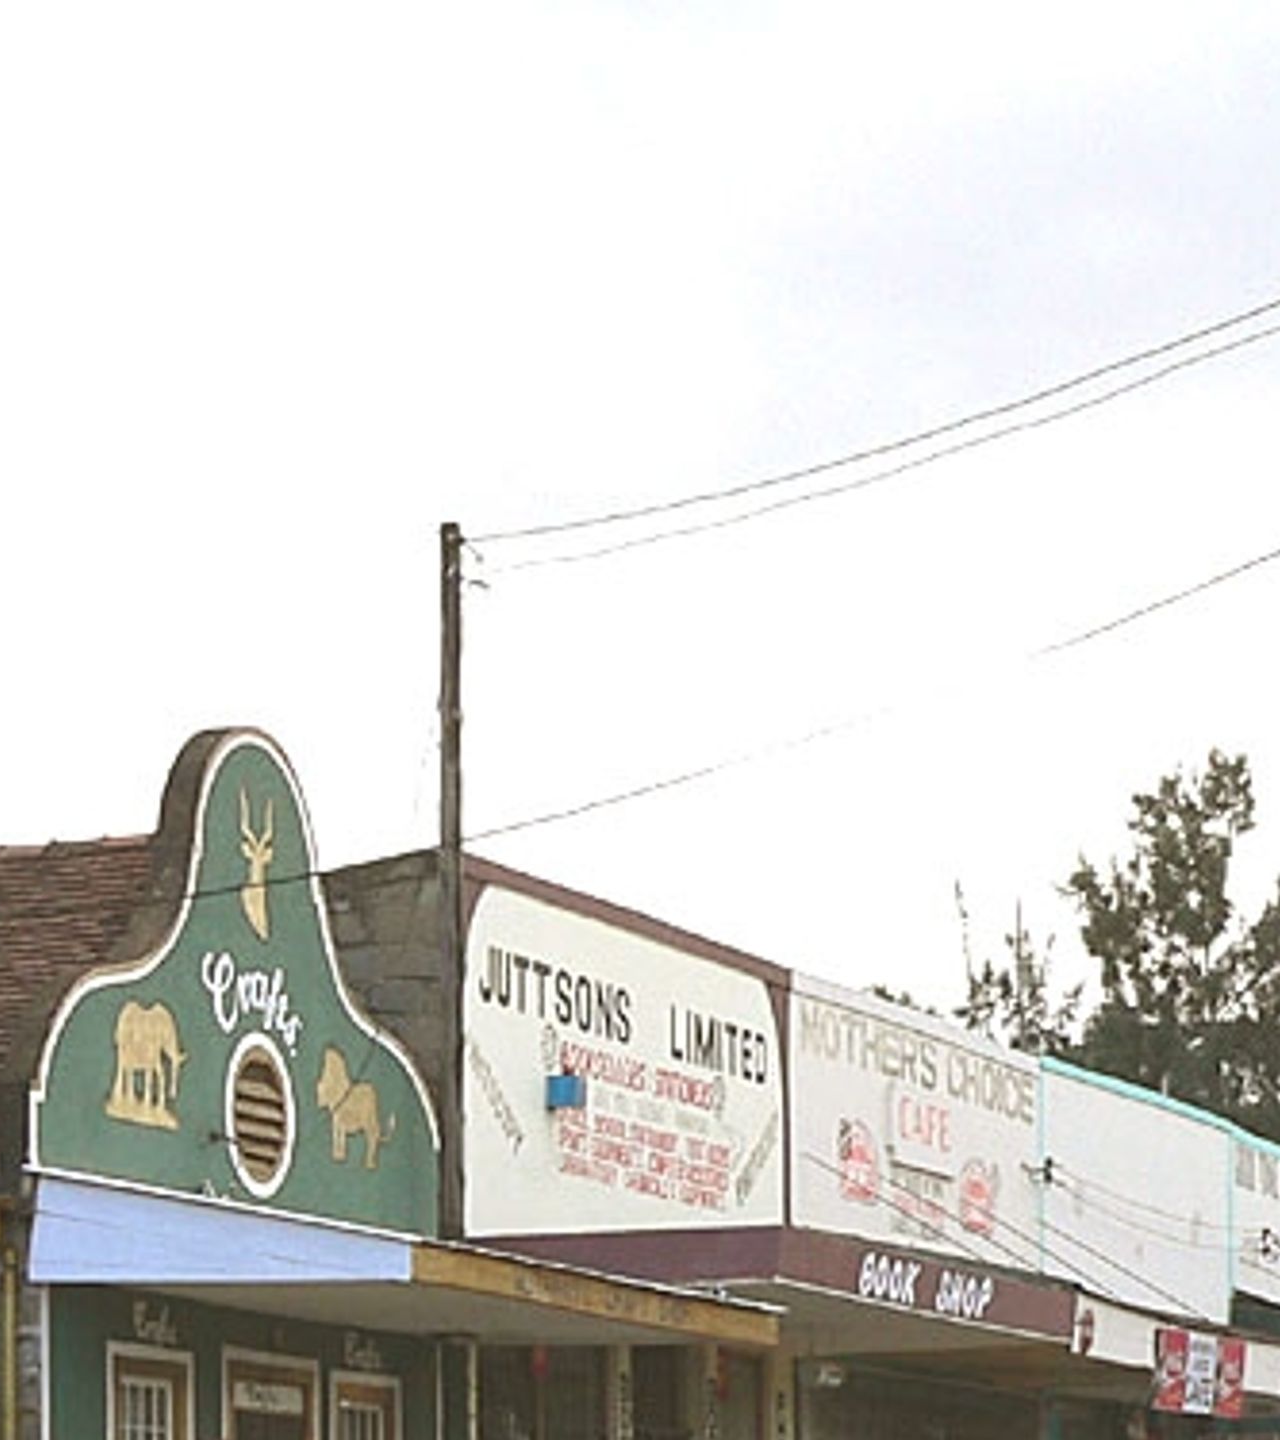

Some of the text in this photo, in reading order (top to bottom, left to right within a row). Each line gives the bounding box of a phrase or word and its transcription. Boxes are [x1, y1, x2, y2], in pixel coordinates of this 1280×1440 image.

[478, 945, 630, 1044] JUTTSONS
[670, 1003, 768, 1084] LIMITED
[899, 1096, 952, 1153] CAFE
[946, 1049, 1035, 1127] CHOICE
[858, 1251, 995, 1320] BOOK SHOP
